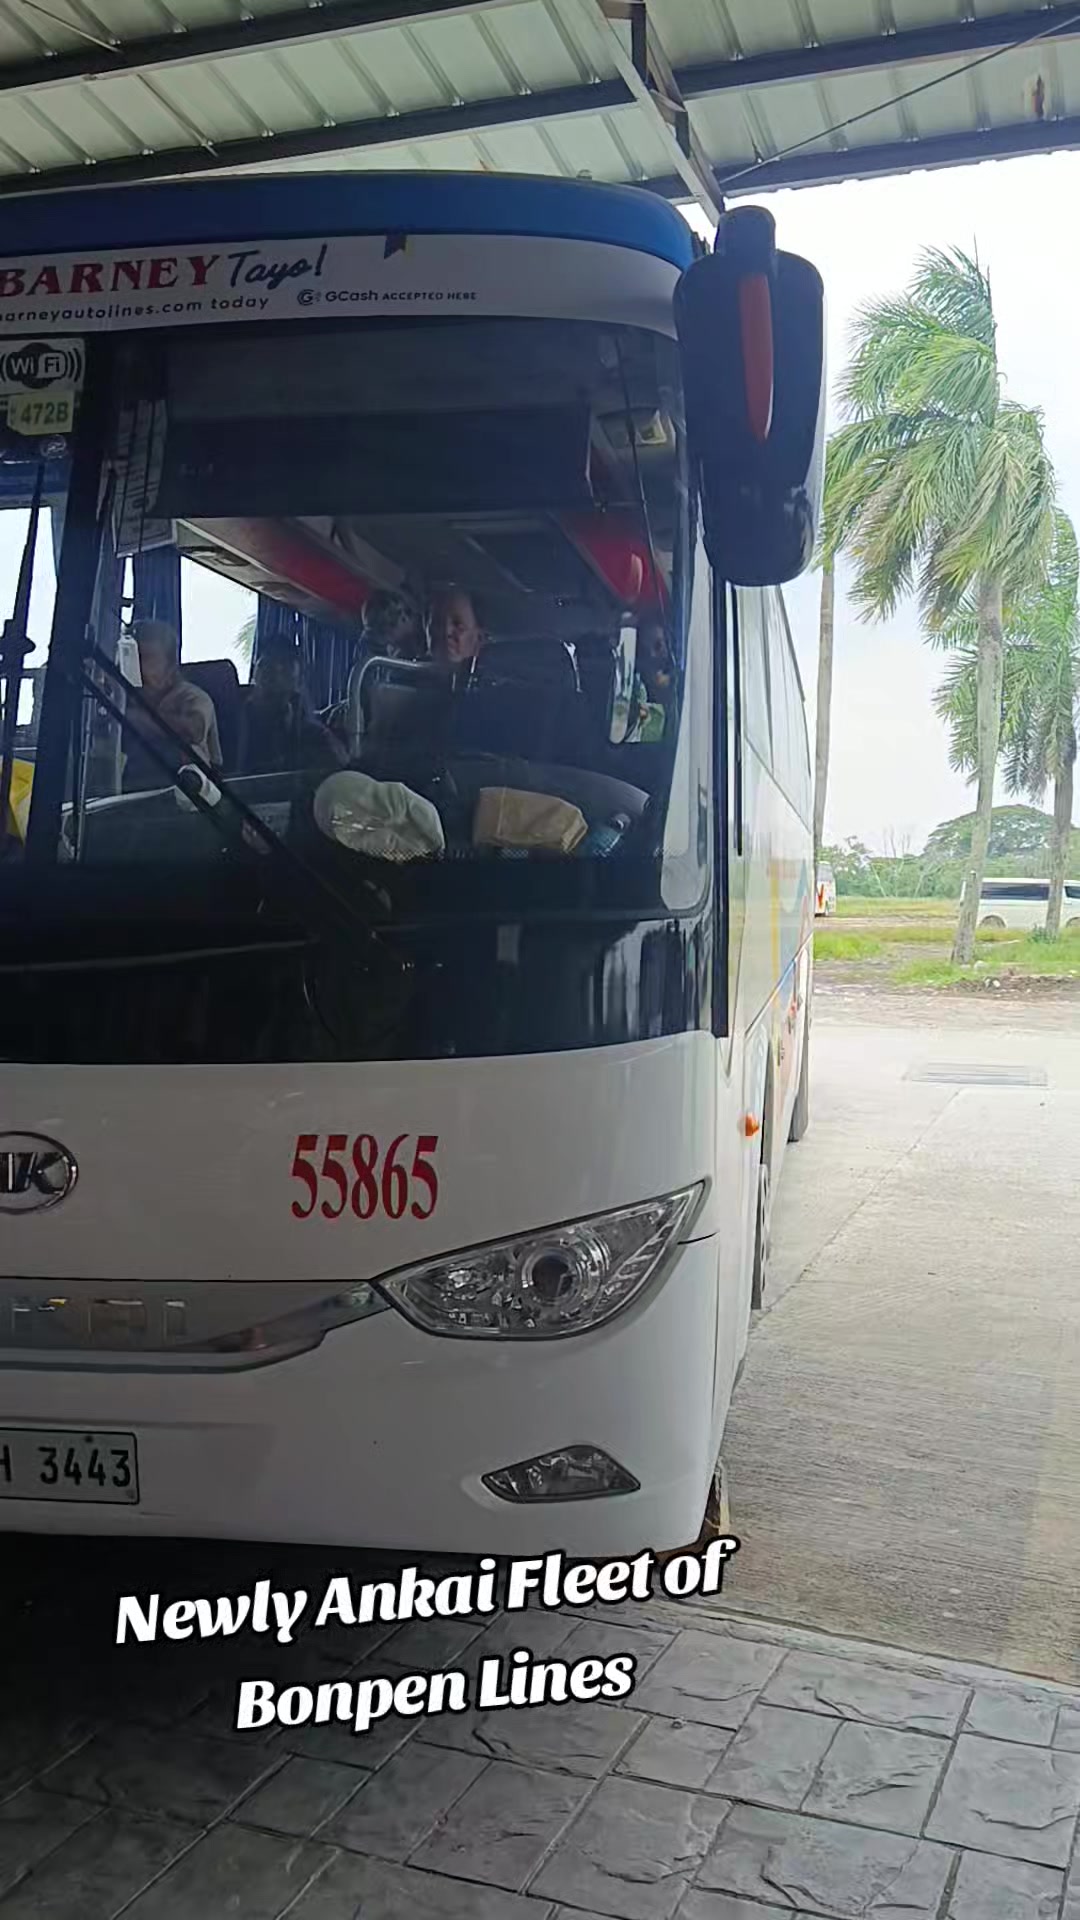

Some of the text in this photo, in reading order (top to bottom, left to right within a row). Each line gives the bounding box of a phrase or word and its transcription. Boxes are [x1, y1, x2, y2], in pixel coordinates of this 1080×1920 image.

[0, 244, 327, 297] BARNEY Tayo!
[0, 295, 269, 323] arneyautolines.com today
[325, 290, 379, 302] GCash
[382, 291, 443, 301] ACCEPTED
[447, 291, 477, 301] HERE
[291, 1133, 439, 1220] 55865
[38, 1446, 131, 1488] 3443
